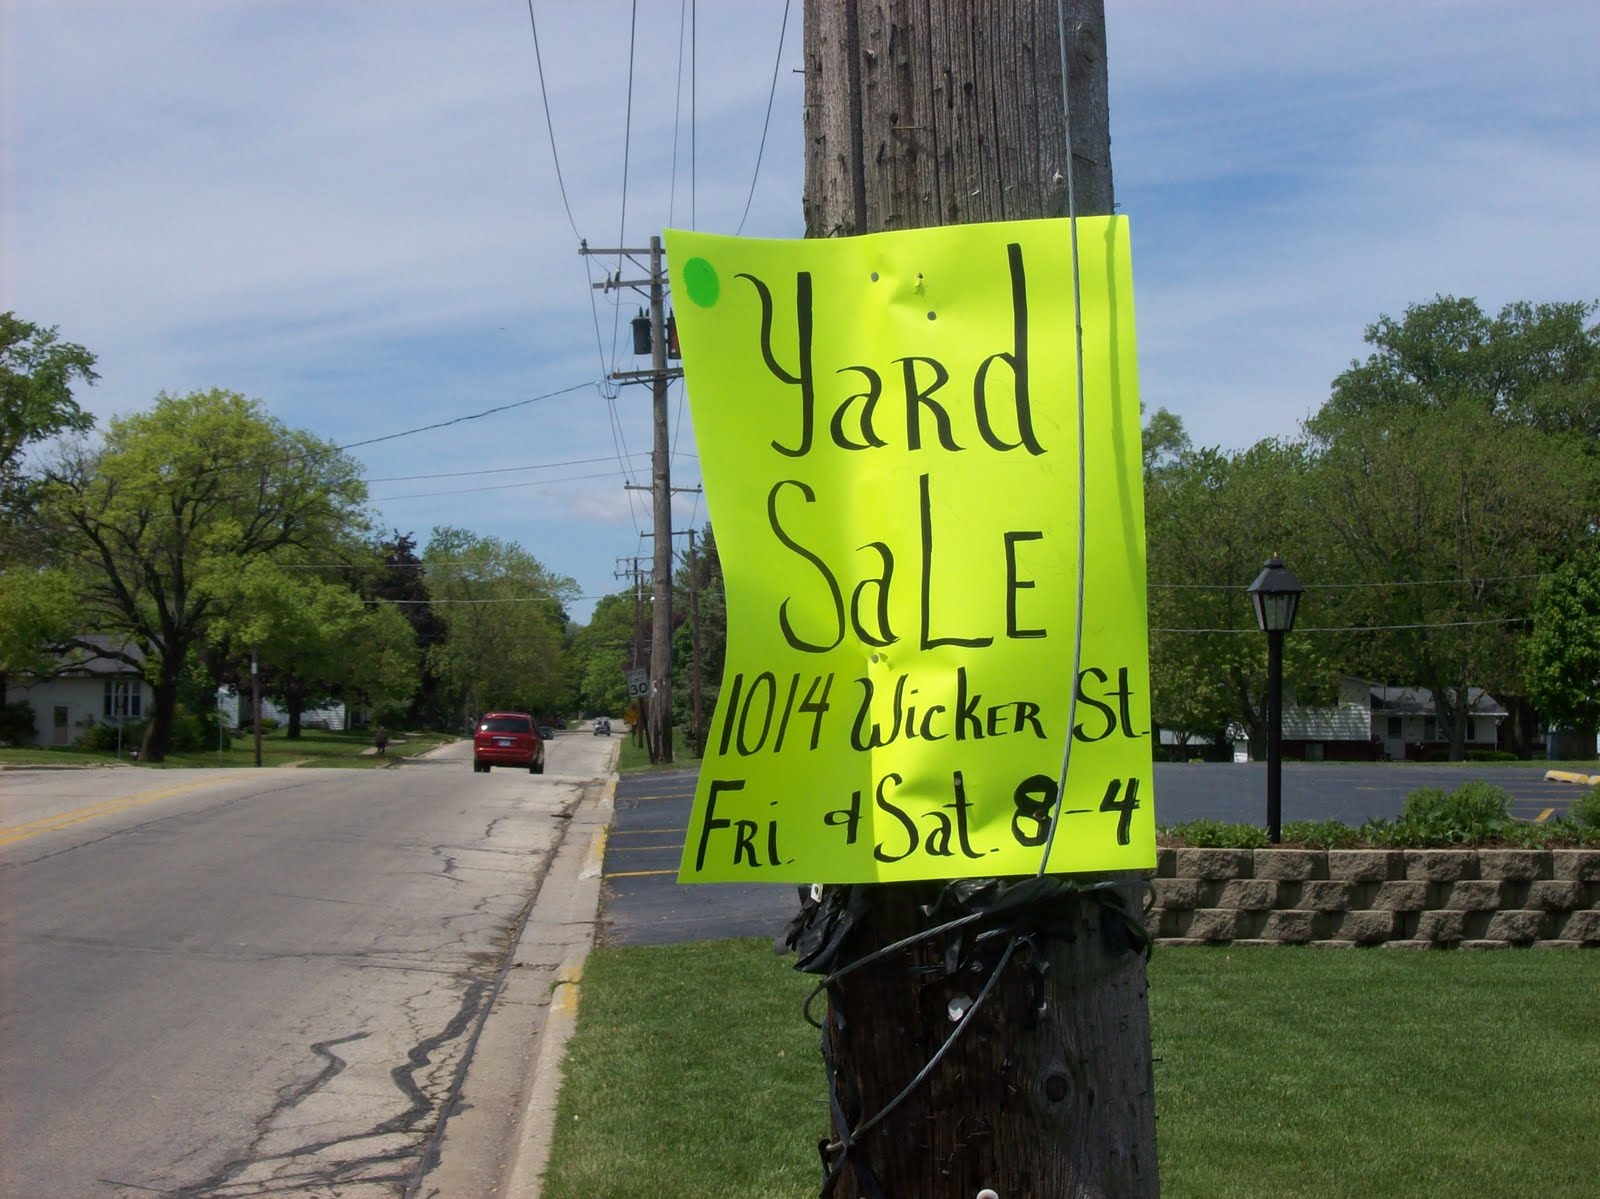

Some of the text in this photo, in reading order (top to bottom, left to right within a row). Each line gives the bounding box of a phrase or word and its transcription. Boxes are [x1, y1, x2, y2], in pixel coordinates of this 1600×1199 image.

[630, 682, 648, 695] 30
[718, 672, 835, 756] 1014
[1073, 667, 1149, 742] St.
[873, 770, 999, 863] Sat.
